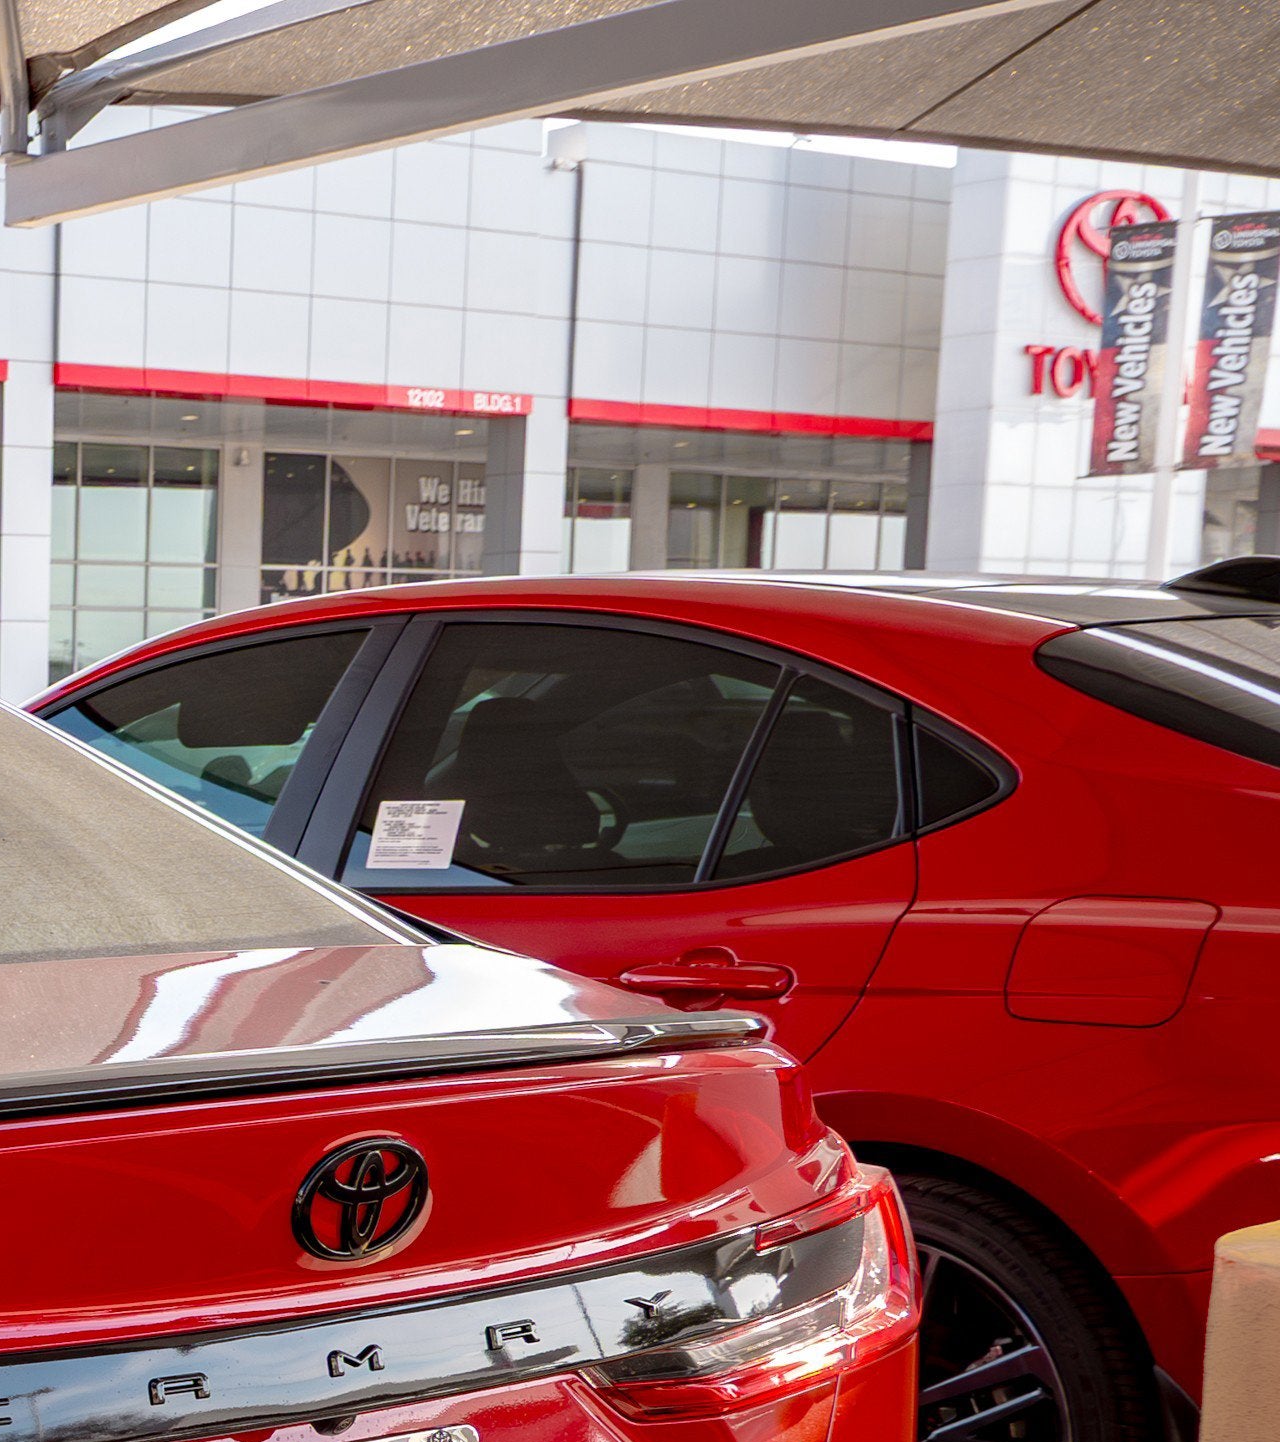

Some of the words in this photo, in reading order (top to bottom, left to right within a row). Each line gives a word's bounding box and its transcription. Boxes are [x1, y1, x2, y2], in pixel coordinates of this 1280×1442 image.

[1113, 281, 1158, 398] Vehicles
[1206, 272, 1260, 391] Vehicles
[407, 388, 445, 408] 12102
[1199, 392, 1240, 457] New
[1107, 399, 1139, 463] New
[418, 476, 450, 504] We
